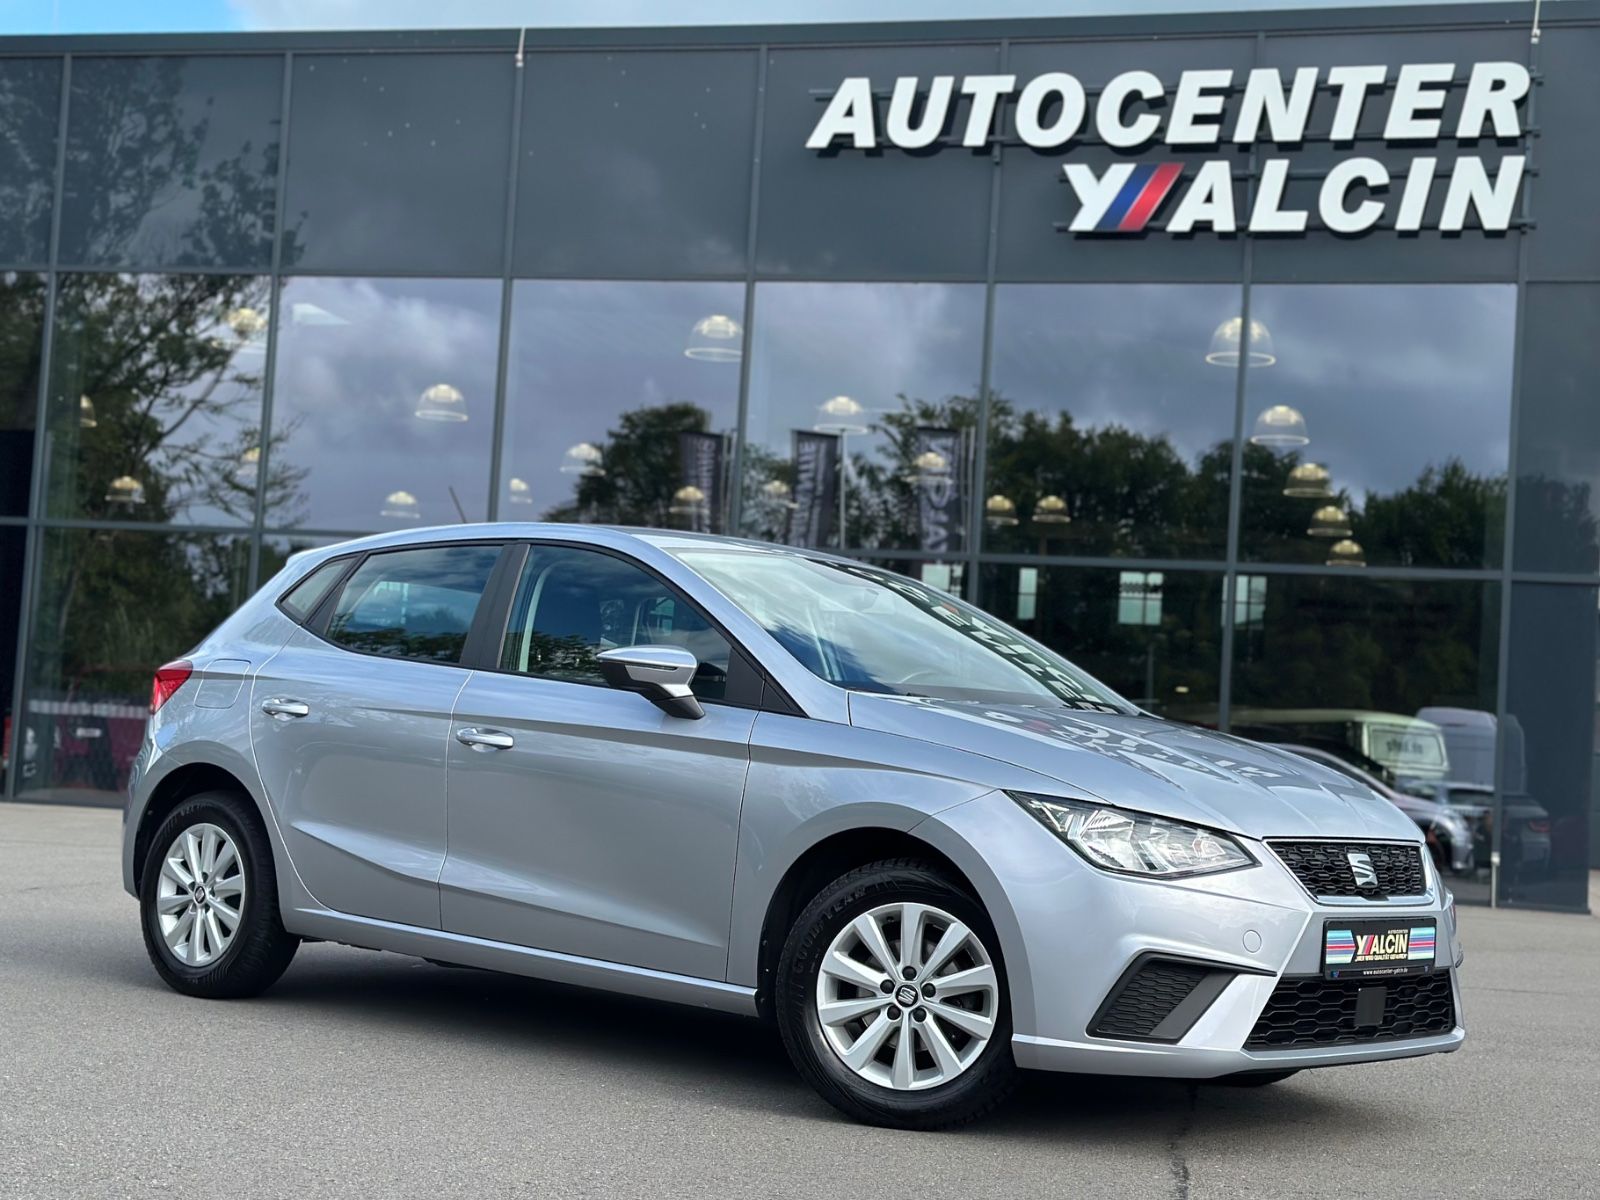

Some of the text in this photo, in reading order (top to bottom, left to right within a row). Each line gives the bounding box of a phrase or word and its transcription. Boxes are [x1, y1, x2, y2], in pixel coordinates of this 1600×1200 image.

[805, 62, 1531, 148] AUTOCENTER
[1063, 155, 1526, 233] YALCIN
[1356, 934, 1408, 956] YALCIN
